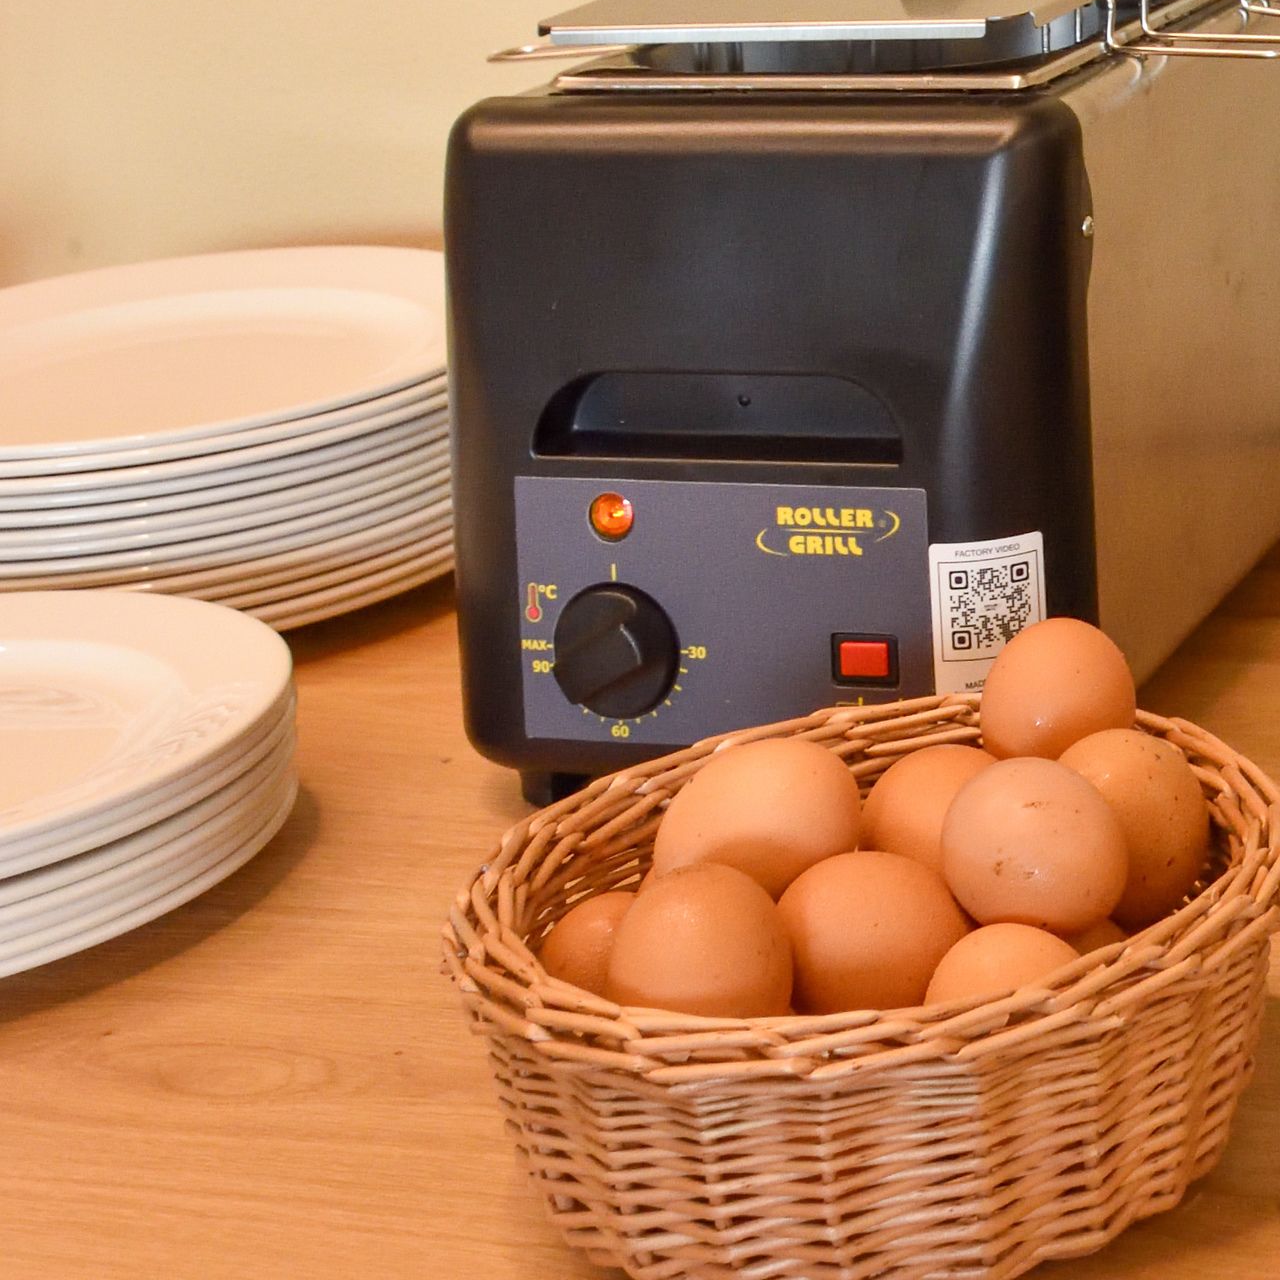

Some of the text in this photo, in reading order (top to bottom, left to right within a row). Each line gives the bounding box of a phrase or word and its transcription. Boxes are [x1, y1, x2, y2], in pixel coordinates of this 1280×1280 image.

[776, 506, 874, 528] ROLLER
[788, 535, 863, 556] GRILL
[954, 542, 1021, 558] FACTORY VIDEO
[521, 639, 548, 651] MAX
[688, 646, 707, 659] 30
[532, 660, 550, 673] 90
[965, 678, 986, 690] MAD
[611, 725, 629, 738] 60
